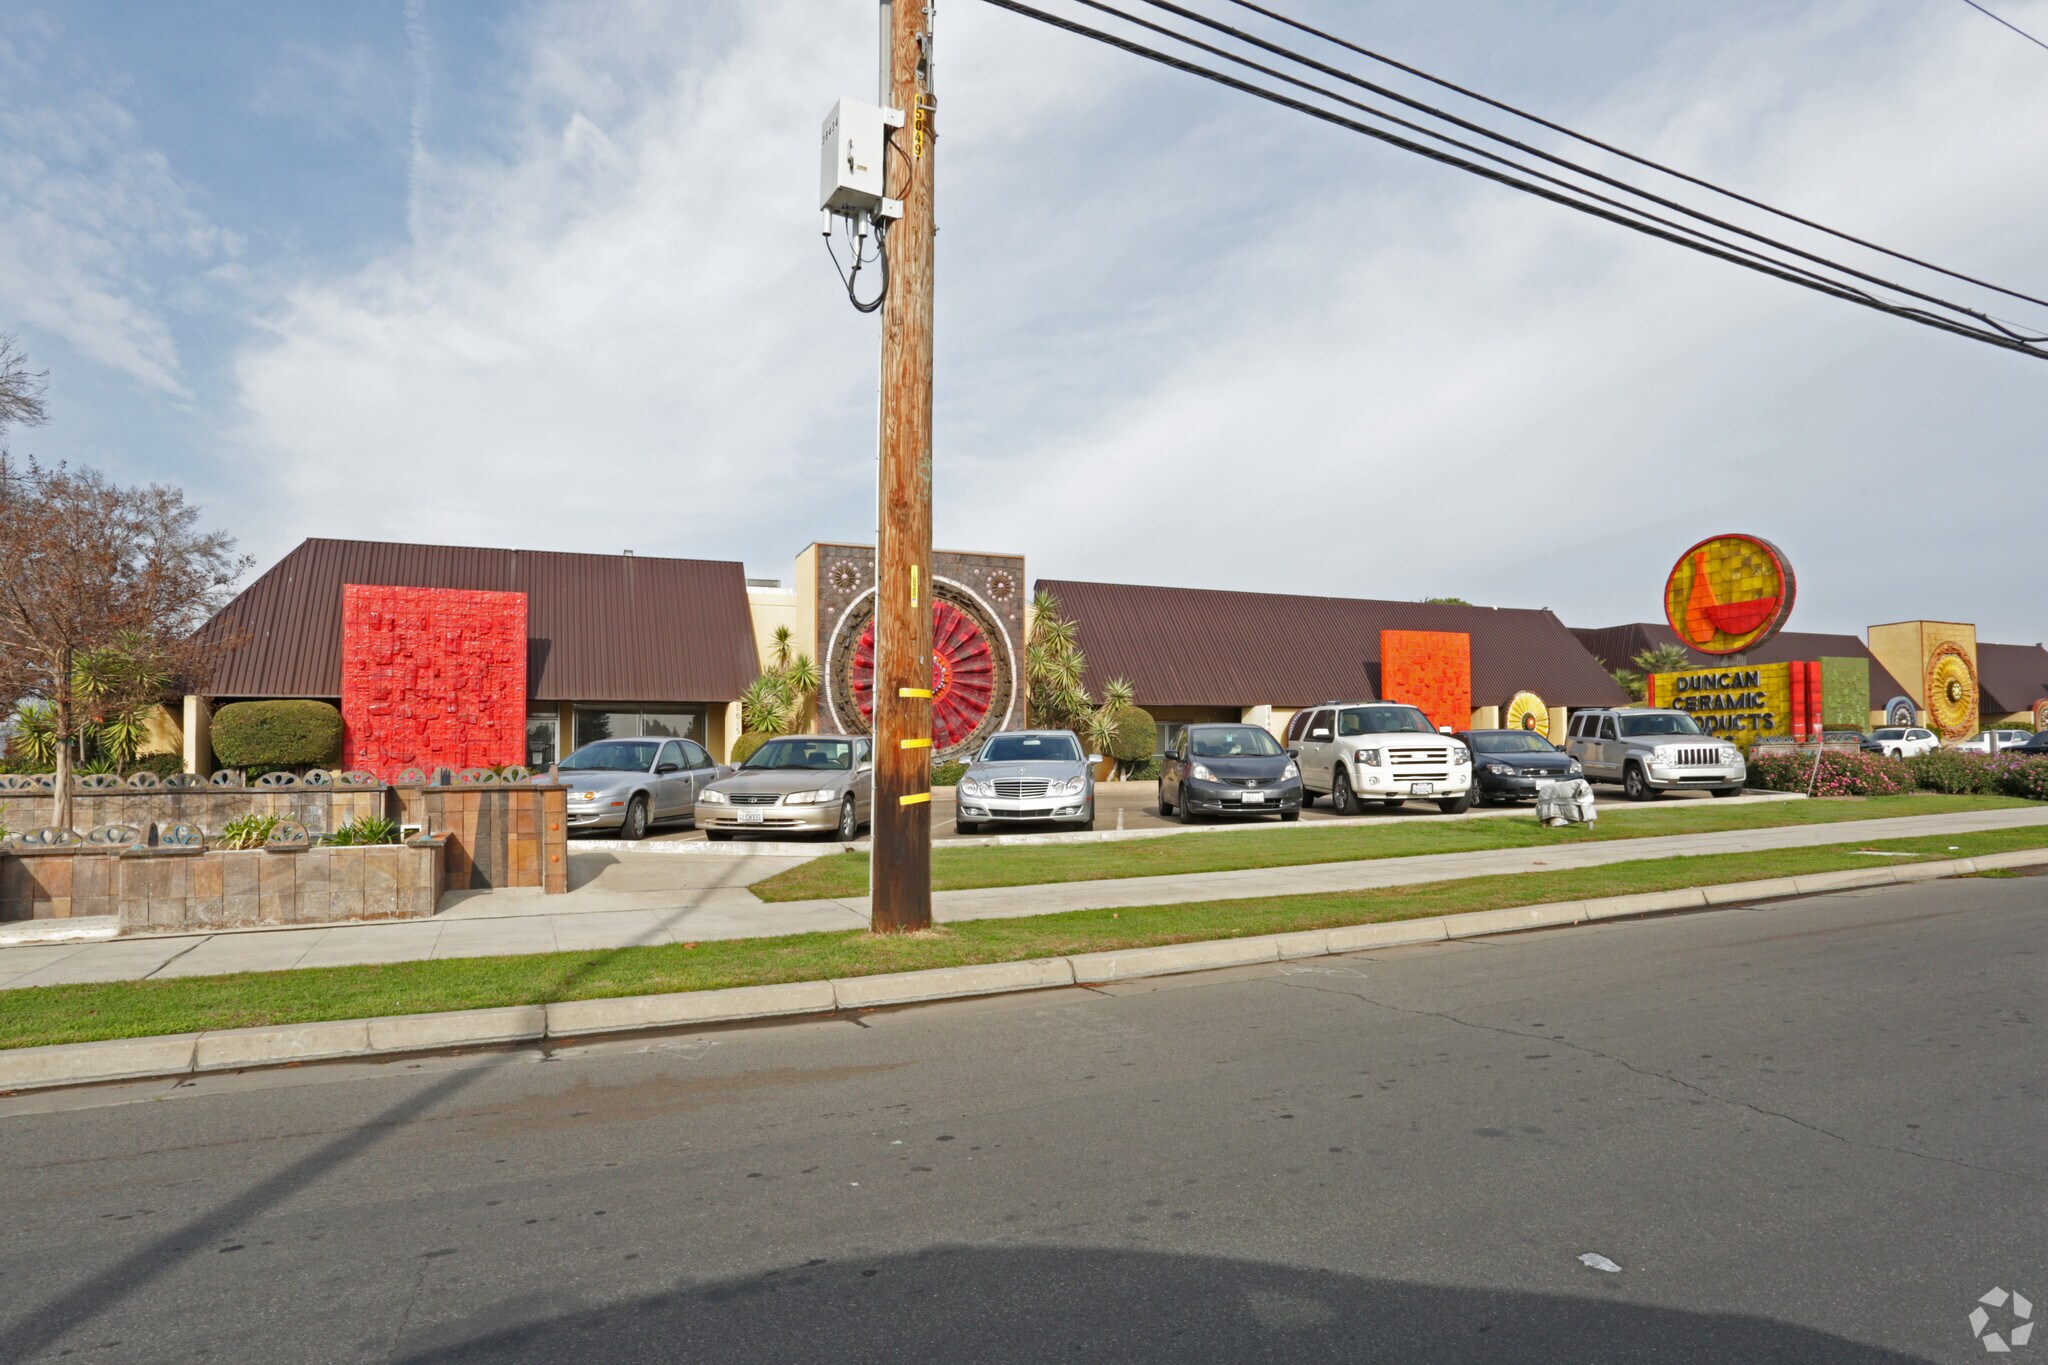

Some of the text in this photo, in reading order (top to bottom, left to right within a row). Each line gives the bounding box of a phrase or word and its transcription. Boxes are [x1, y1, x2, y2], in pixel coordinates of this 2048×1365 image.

[1677, 671, 1760, 691] DUNCAN
[1673, 692, 1766, 711] CERAMIC
[1695, 712, 1774, 730] ODUCTS
